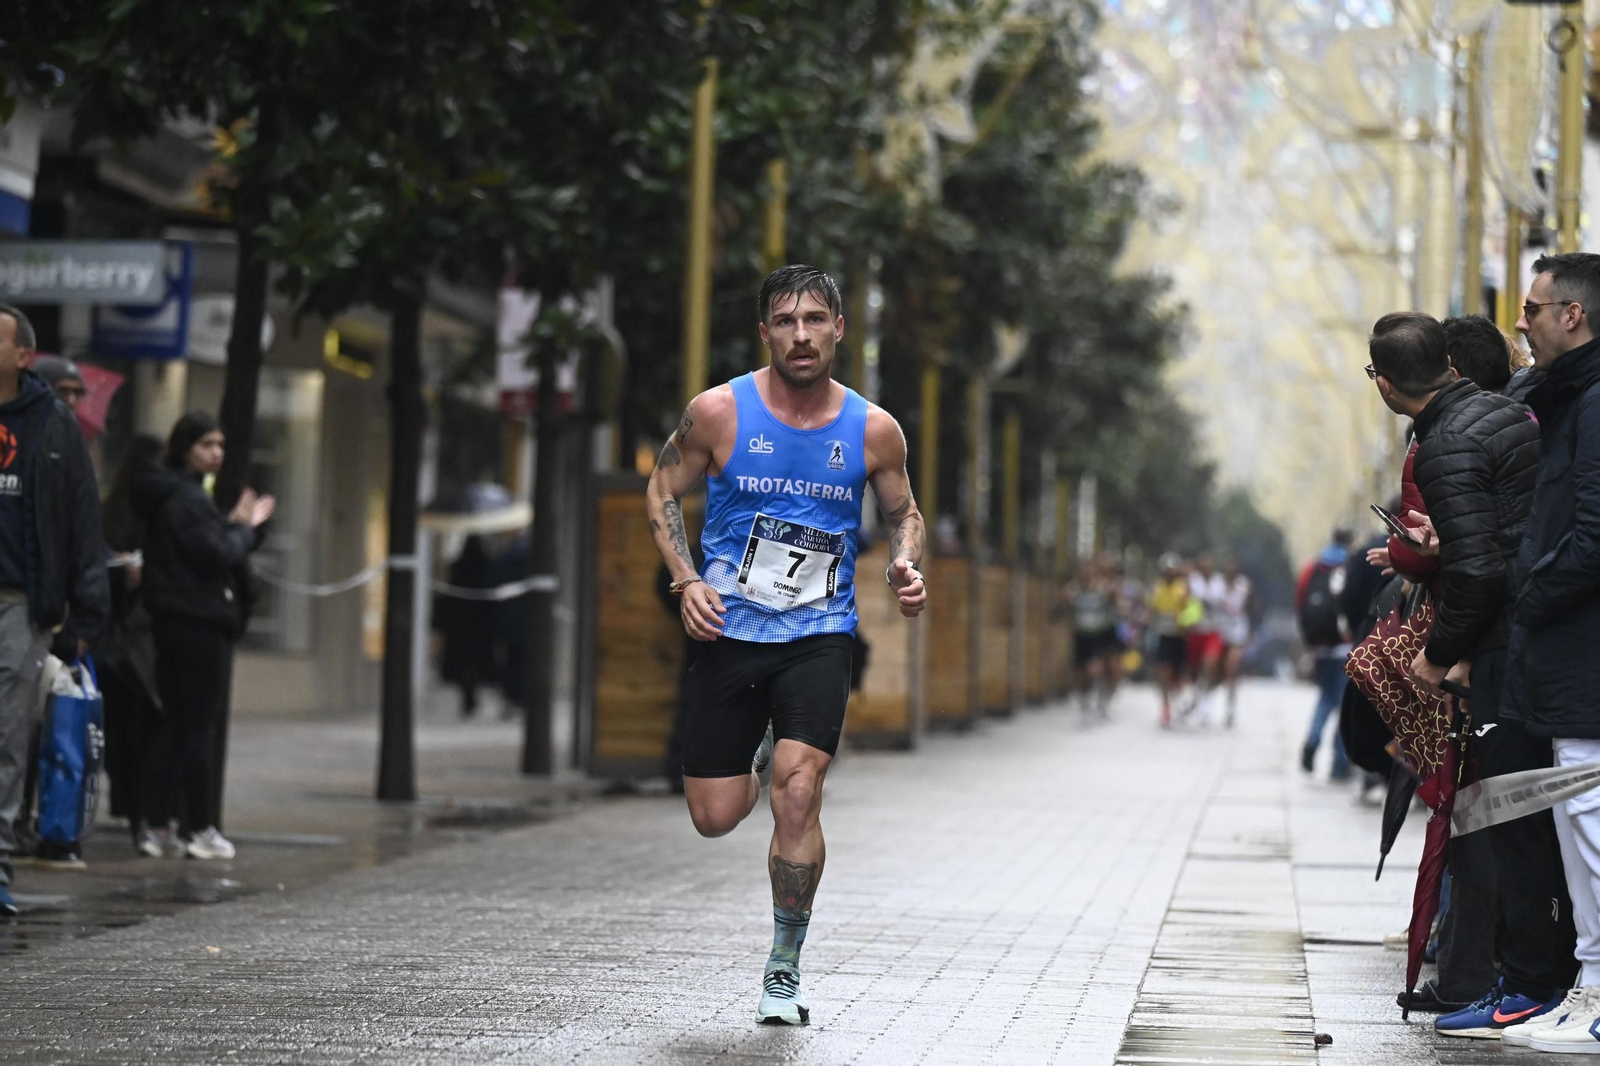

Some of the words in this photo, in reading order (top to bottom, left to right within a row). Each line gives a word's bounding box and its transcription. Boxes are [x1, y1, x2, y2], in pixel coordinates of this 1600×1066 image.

[748, 433, 774, 454] als
[736, 475, 853, 501] TROTASIERRA
[802, 526, 832, 539] MEDIA
[787, 550, 807, 578] 7
[773, 581, 802, 595] DOMINGO
